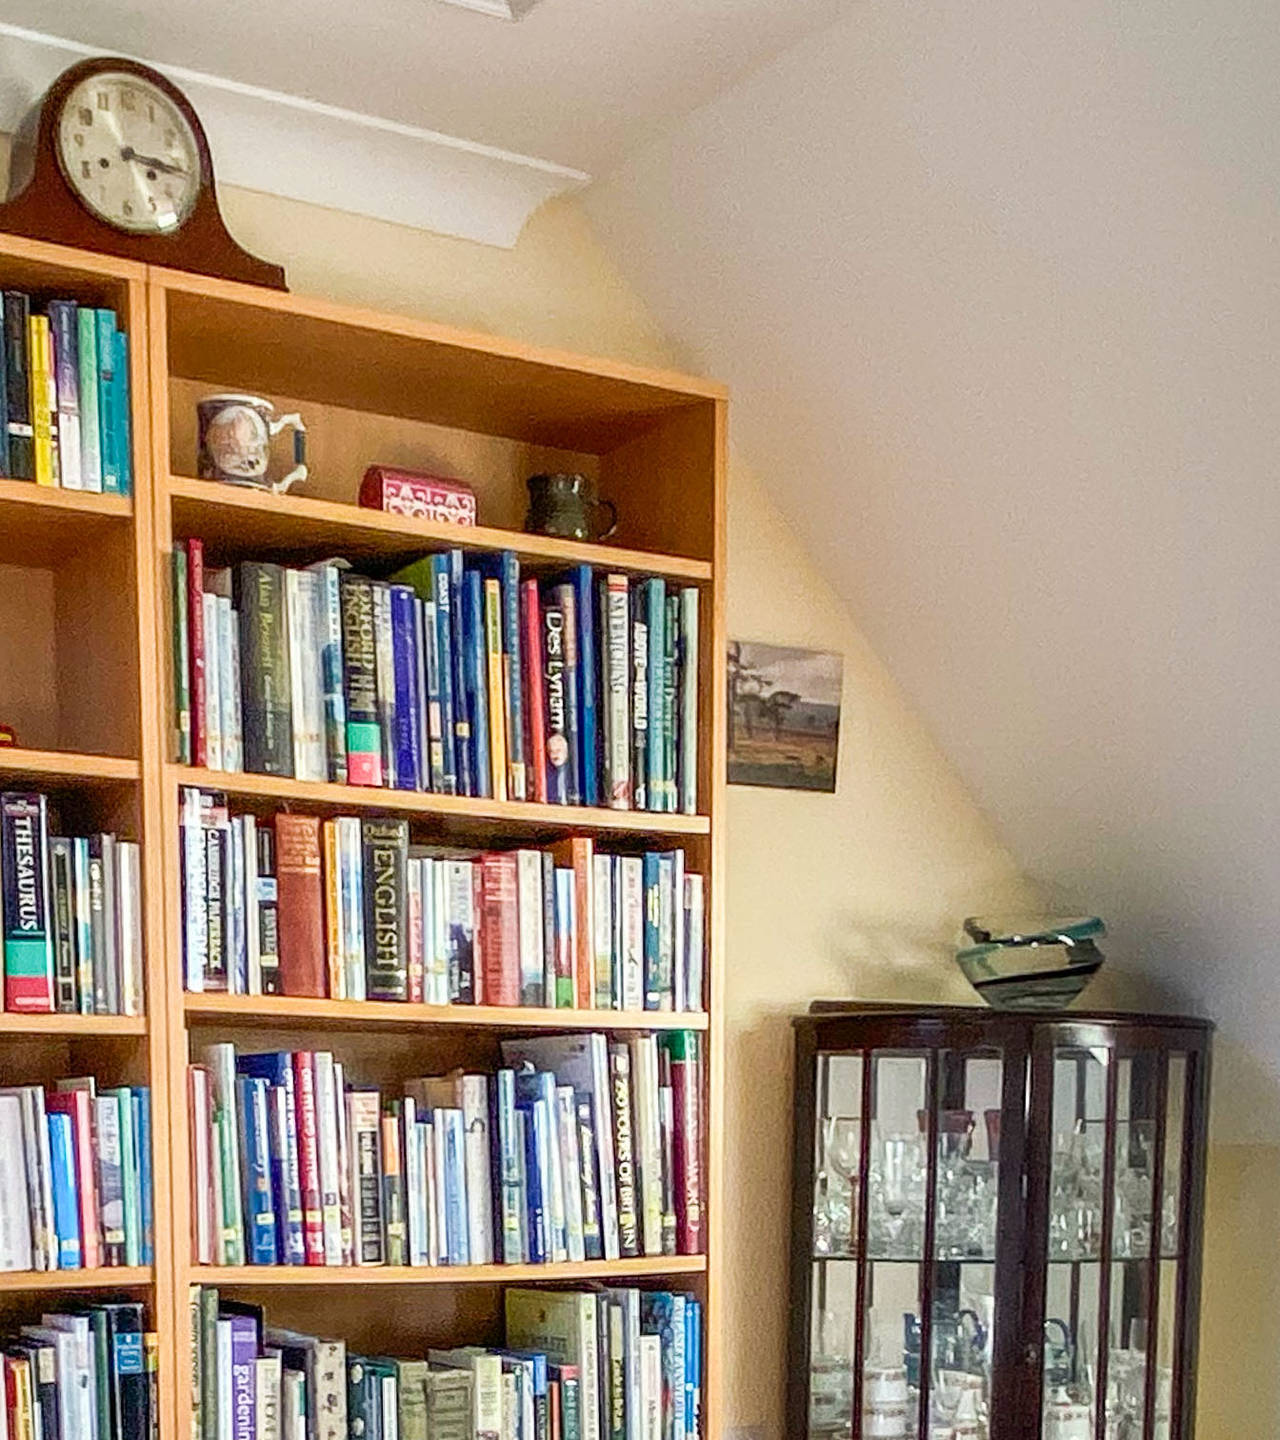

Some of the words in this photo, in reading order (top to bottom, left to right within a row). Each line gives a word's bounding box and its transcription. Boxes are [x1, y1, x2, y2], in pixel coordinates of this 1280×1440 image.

[545, 612, 565, 656] Des
[543, 661, 566, 731] Lynam
[14, 815, 38, 933] THESAURUS
[372, 848, 400, 967] ENGLISH
[617, 1108, 632, 1162] TOURS
[619, 1161, 633, 1184] OF
